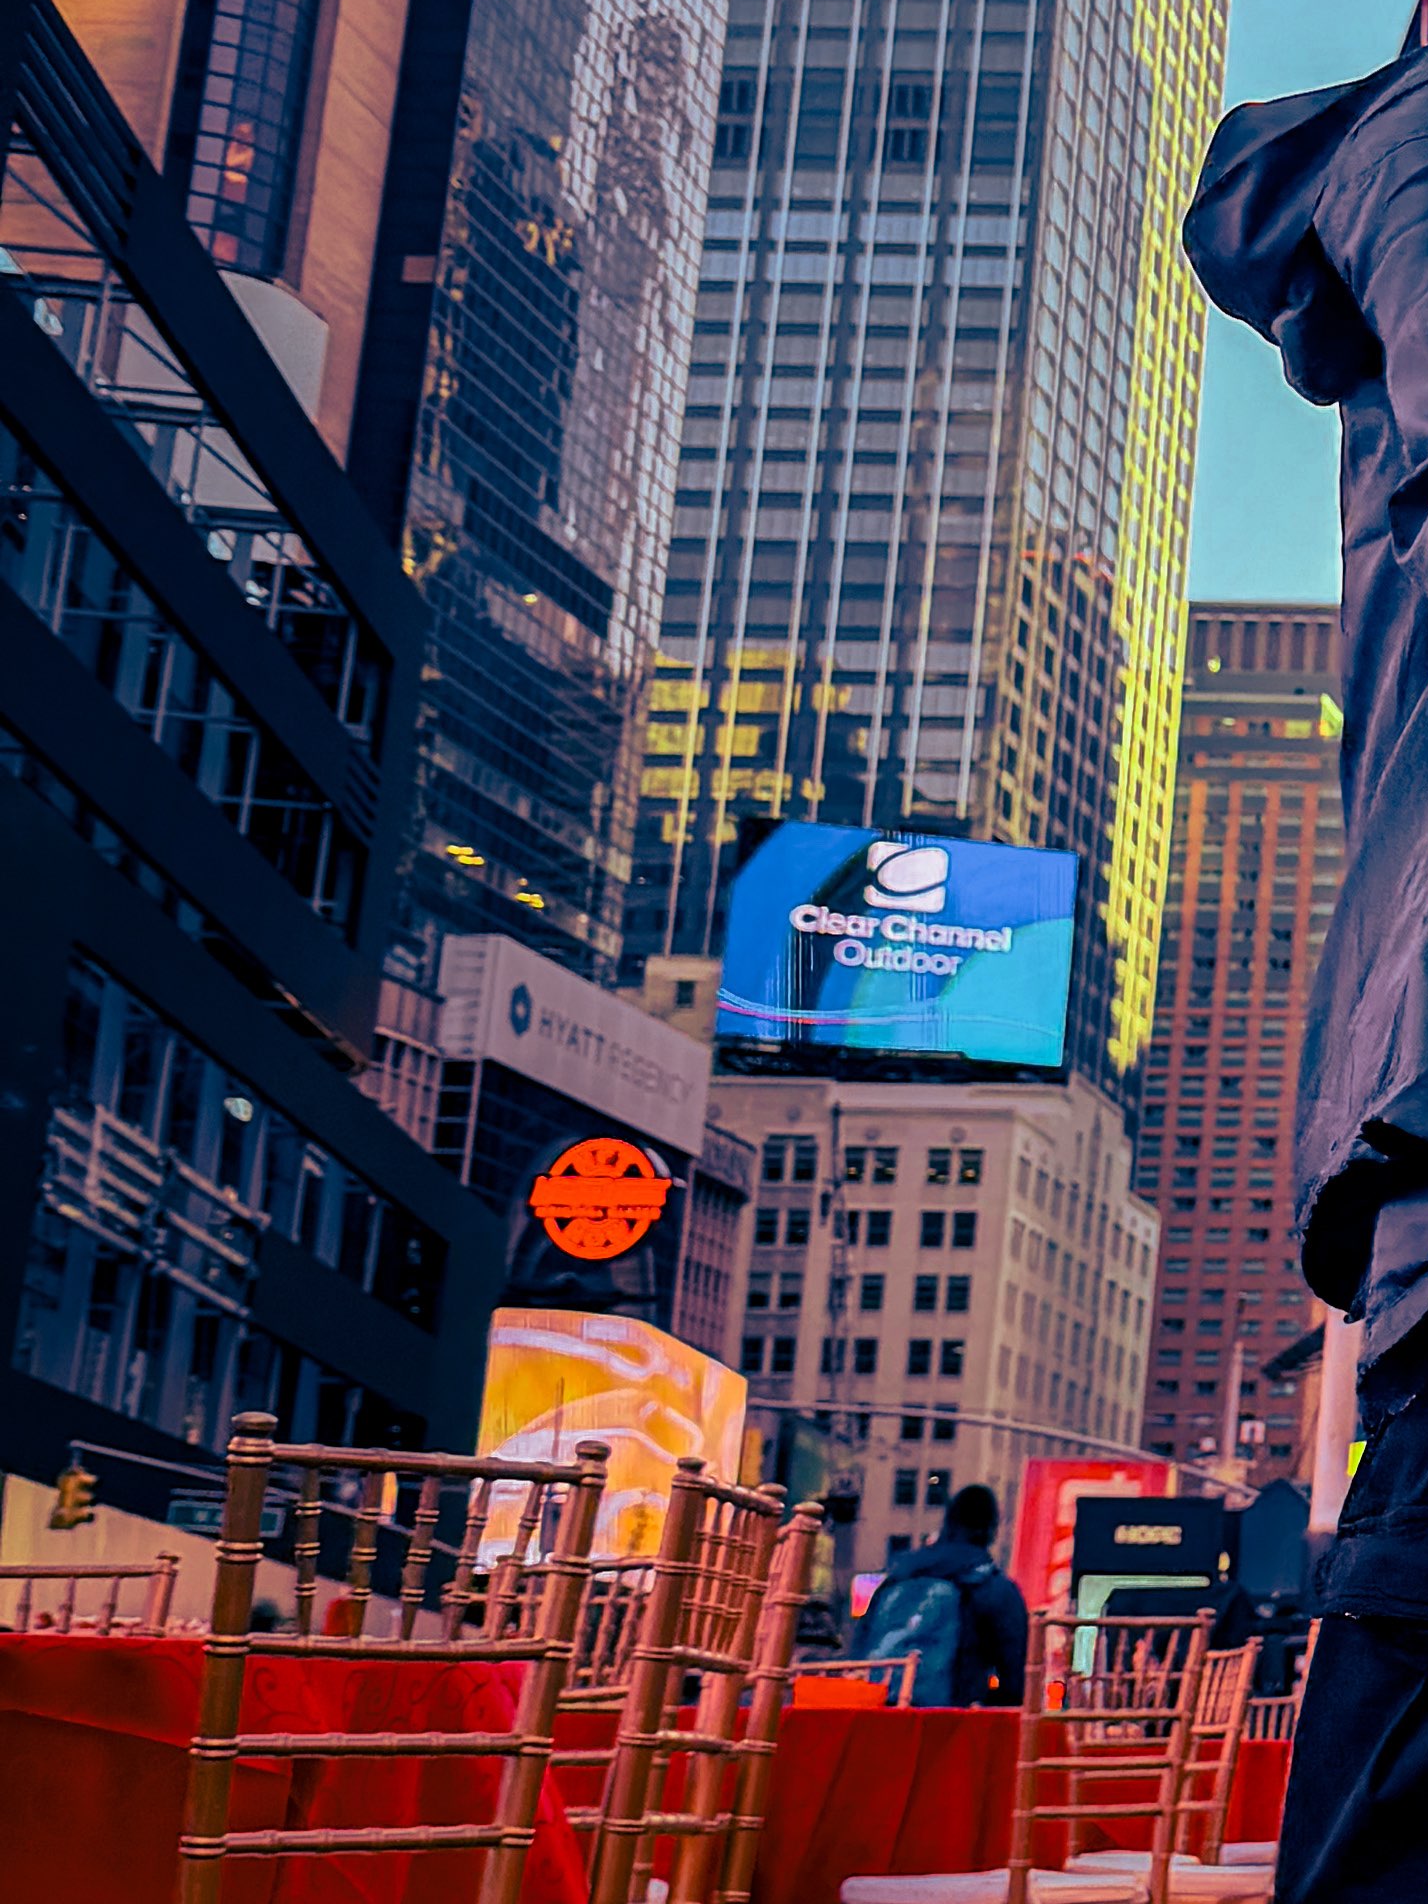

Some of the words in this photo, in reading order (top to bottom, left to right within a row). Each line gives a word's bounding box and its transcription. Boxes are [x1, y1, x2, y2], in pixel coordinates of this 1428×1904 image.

[789, 904, 880, 940] Clear
[881, 911, 1013, 952] Channel
[833, 937, 964, 977] Outdoor
[539, 1006, 605, 1065] HYATT
